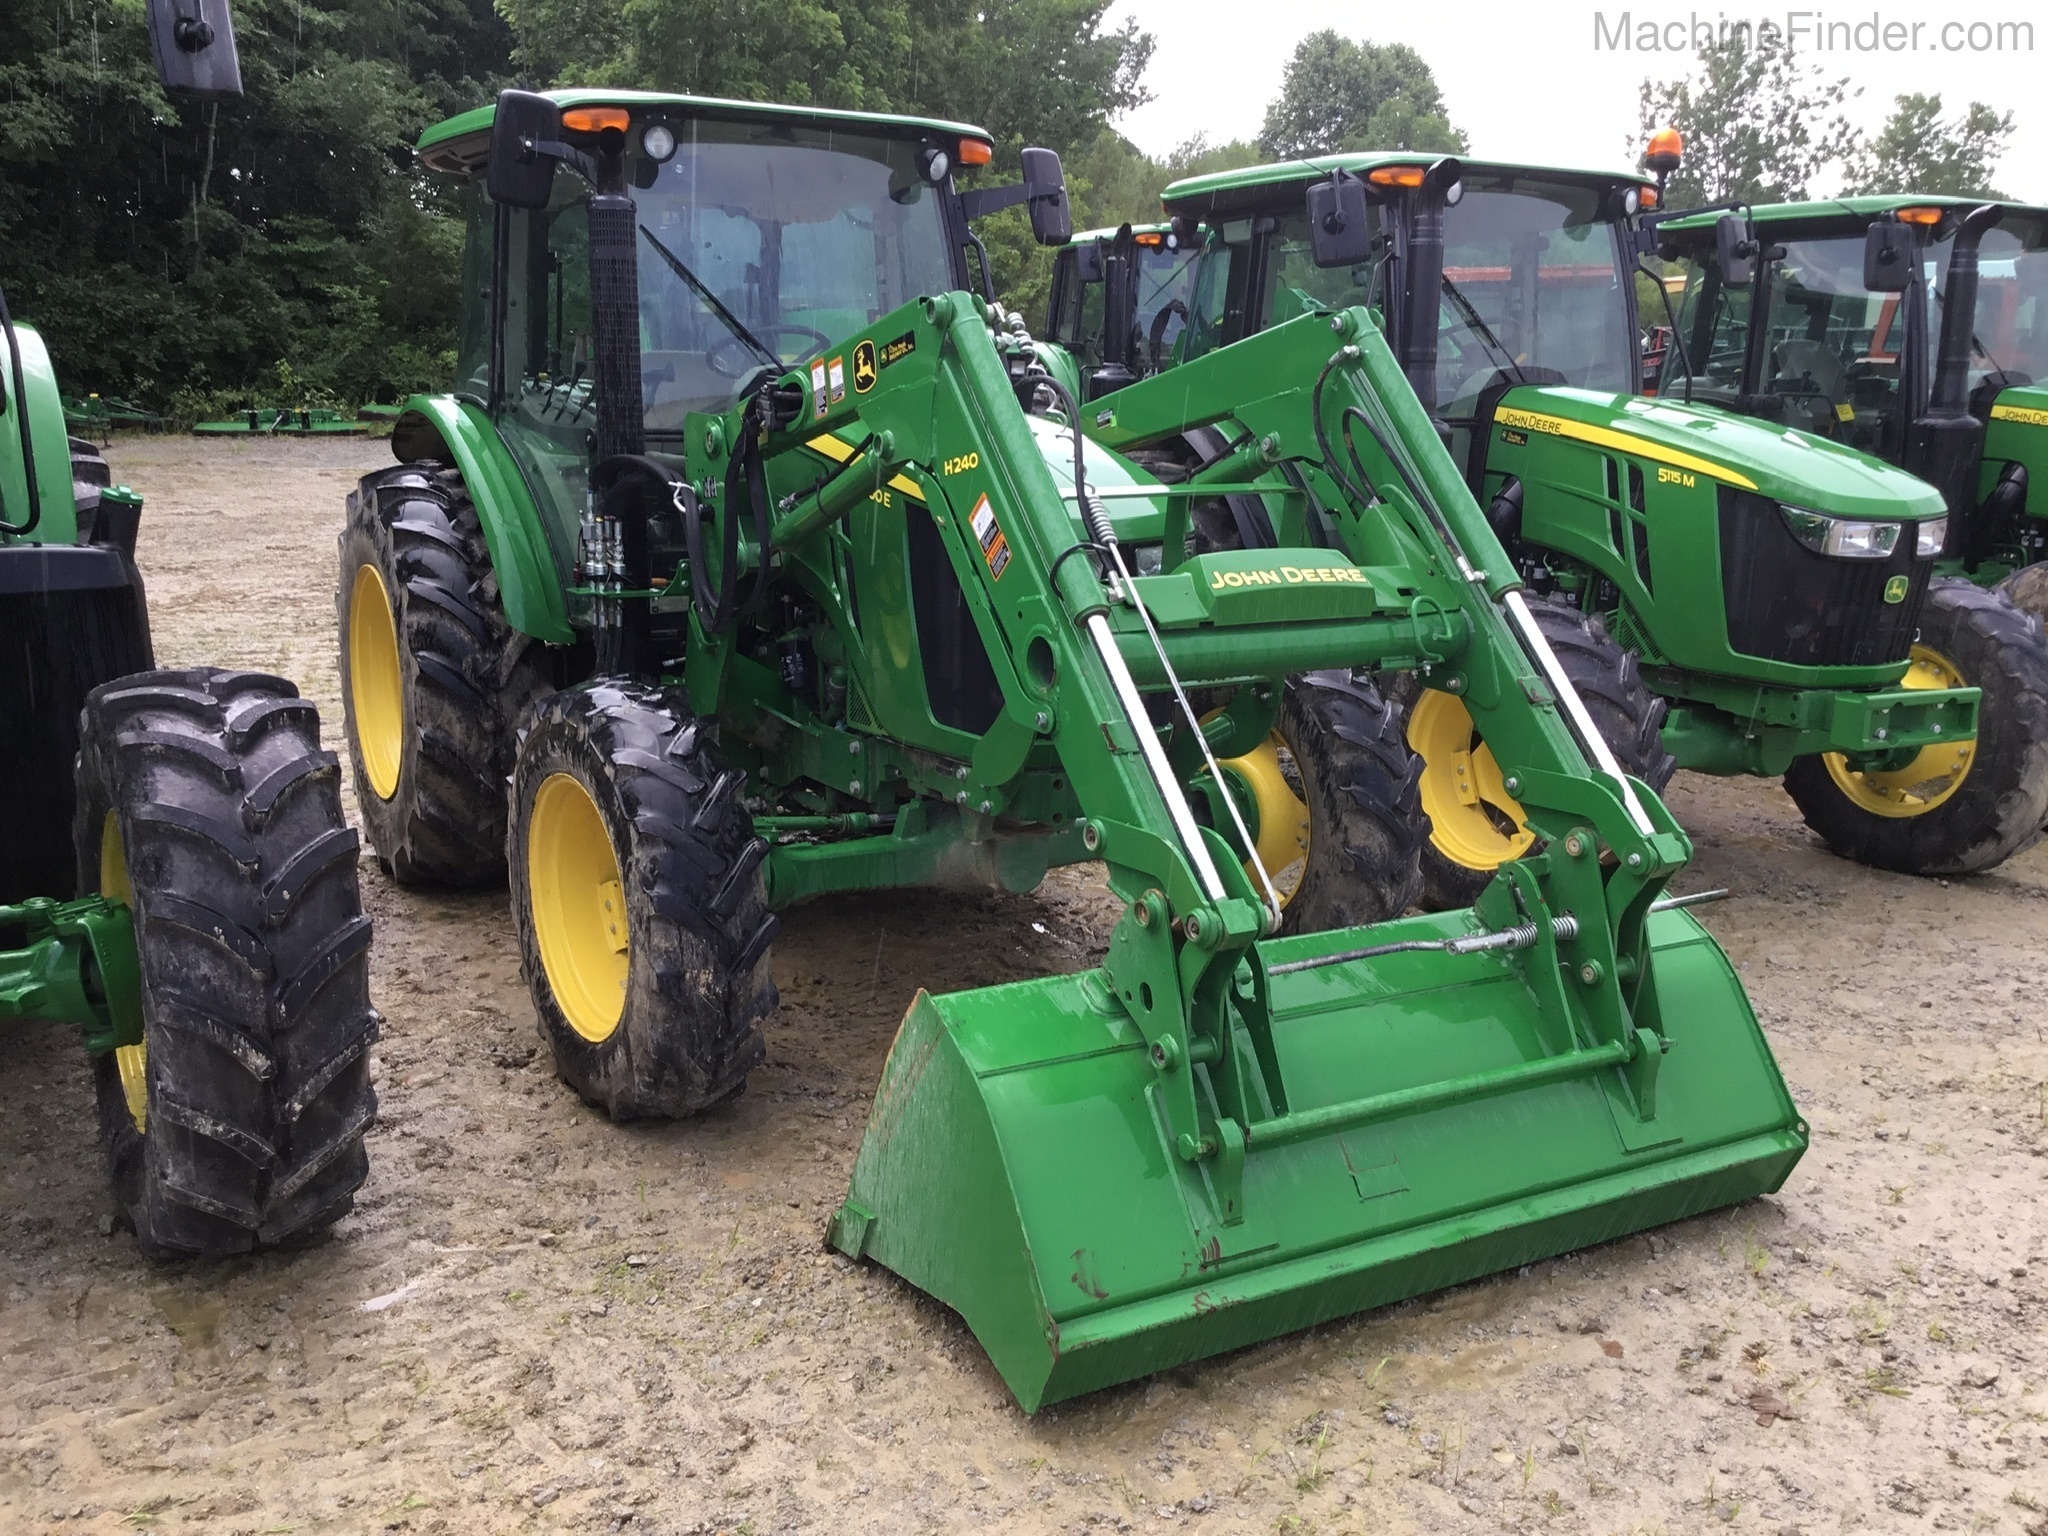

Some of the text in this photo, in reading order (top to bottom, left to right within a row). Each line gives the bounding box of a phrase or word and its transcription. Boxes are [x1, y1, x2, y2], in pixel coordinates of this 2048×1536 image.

[1502, 411, 1562, 433] JOHN DEERE
[2001, 409, 2031, 422] JOHN
[944, 452, 978, 476] H240
[1210, 566, 1367, 590] JOHN DEERE
